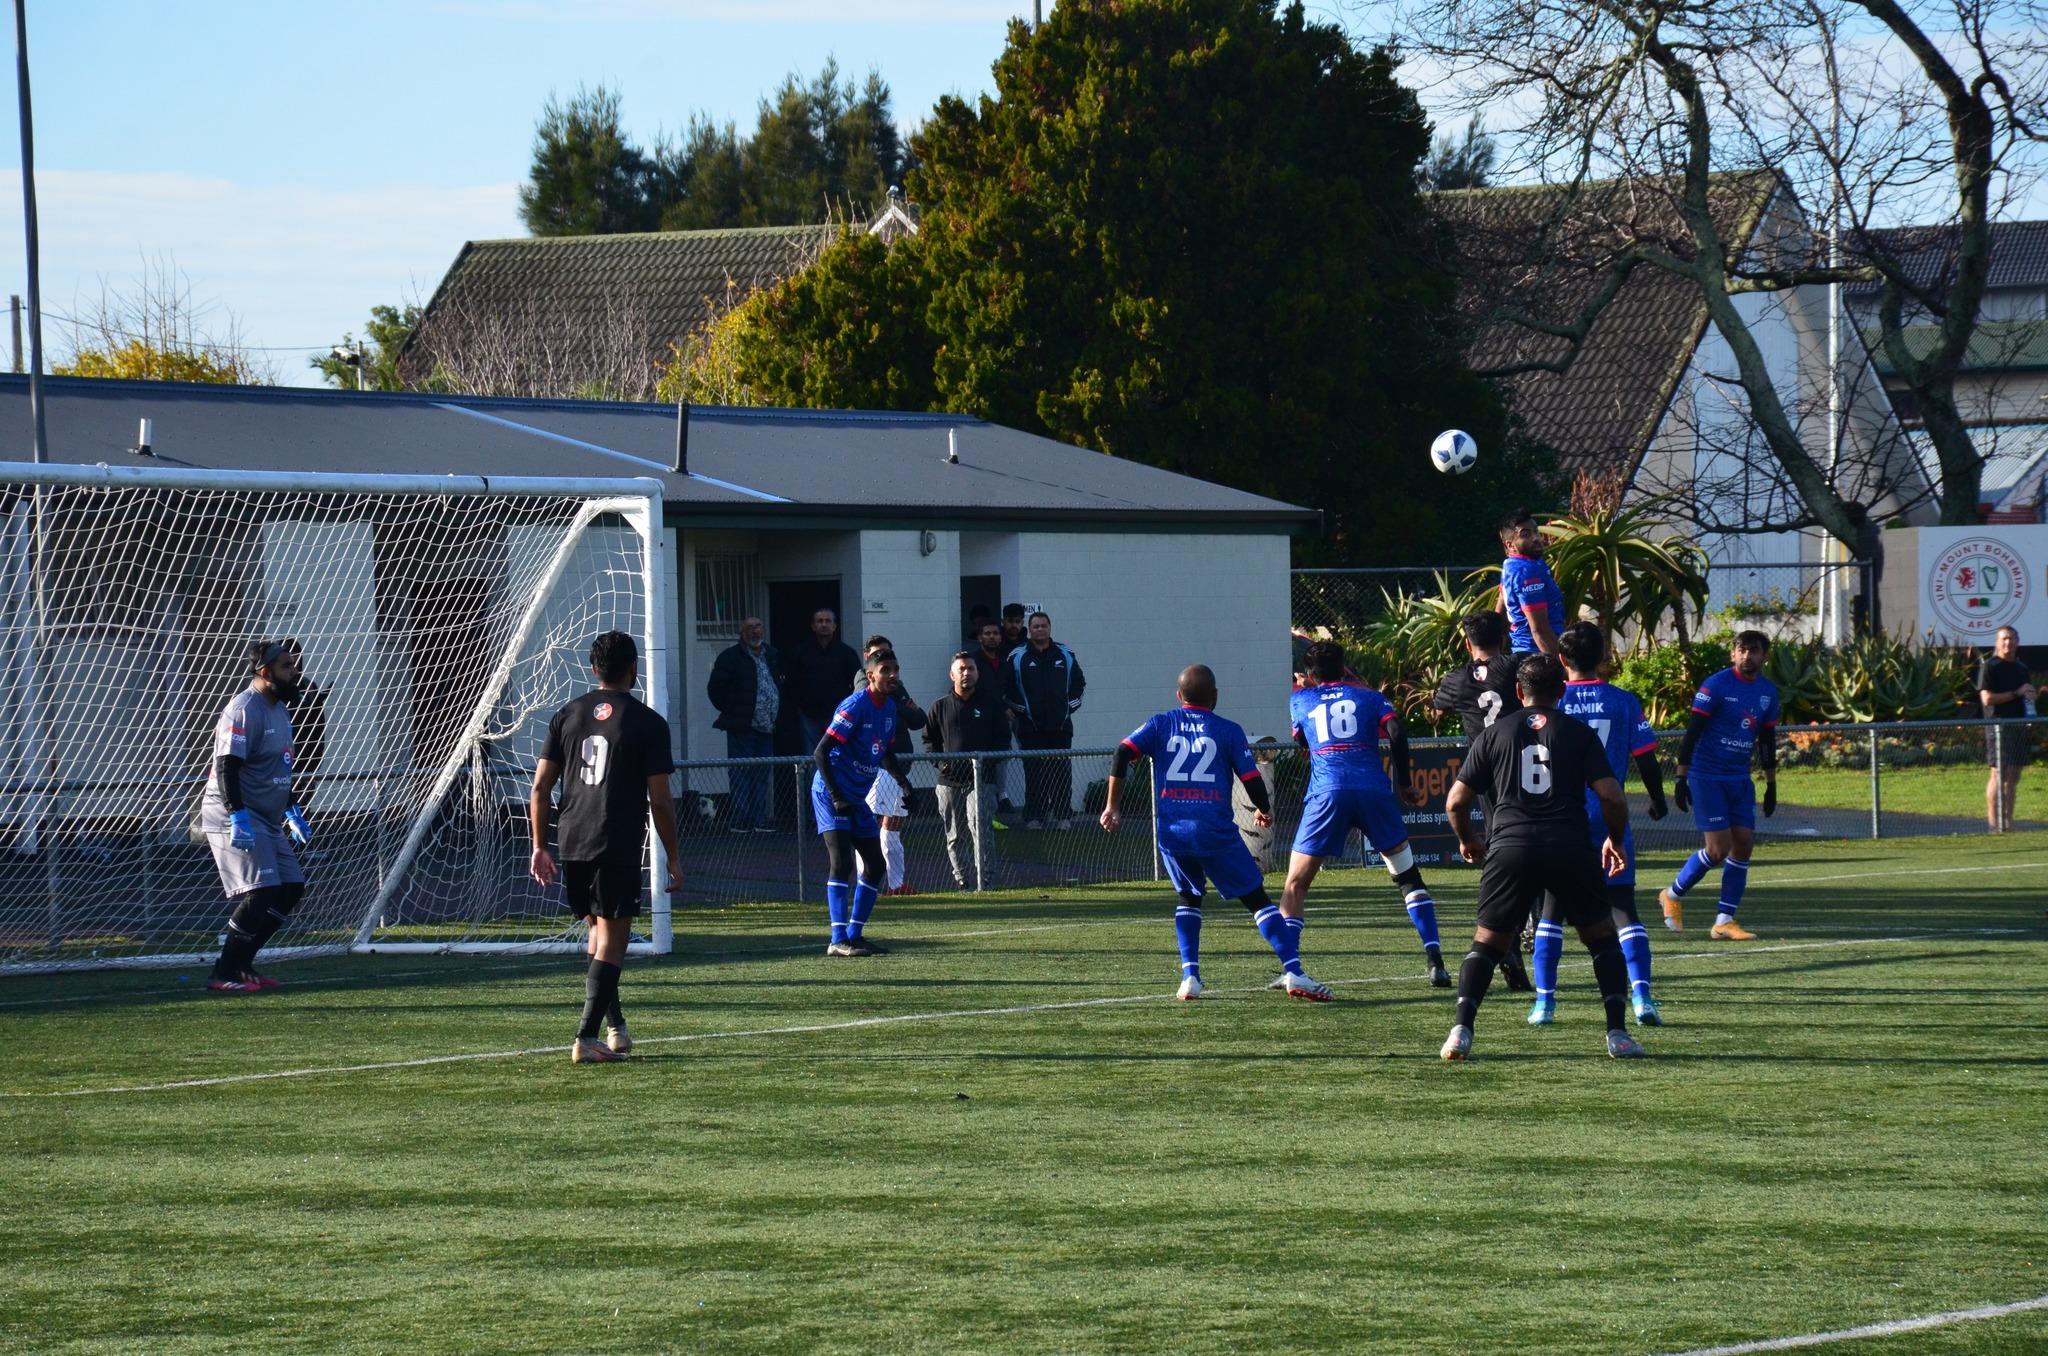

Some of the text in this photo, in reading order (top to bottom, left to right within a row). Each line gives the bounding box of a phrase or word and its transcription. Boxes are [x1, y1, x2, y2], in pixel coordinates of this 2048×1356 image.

[1935, 544, 2023, 602] UNI-MOUNT BOHEMIAN
[1967, 620, 1993, 629] AFC
[1307, 699, 1358, 744] 18
[1564, 702, 1604, 714] SAMIK
[1180, 722, 1205, 732] HAK
[580, 735, 609, 786] 9
[1166, 735, 1217, 782] 22
[1521, 744, 1551, 794] 6
[1160, 786, 1225, 801] MOGUL
[1416, 811, 1433, 824] class
